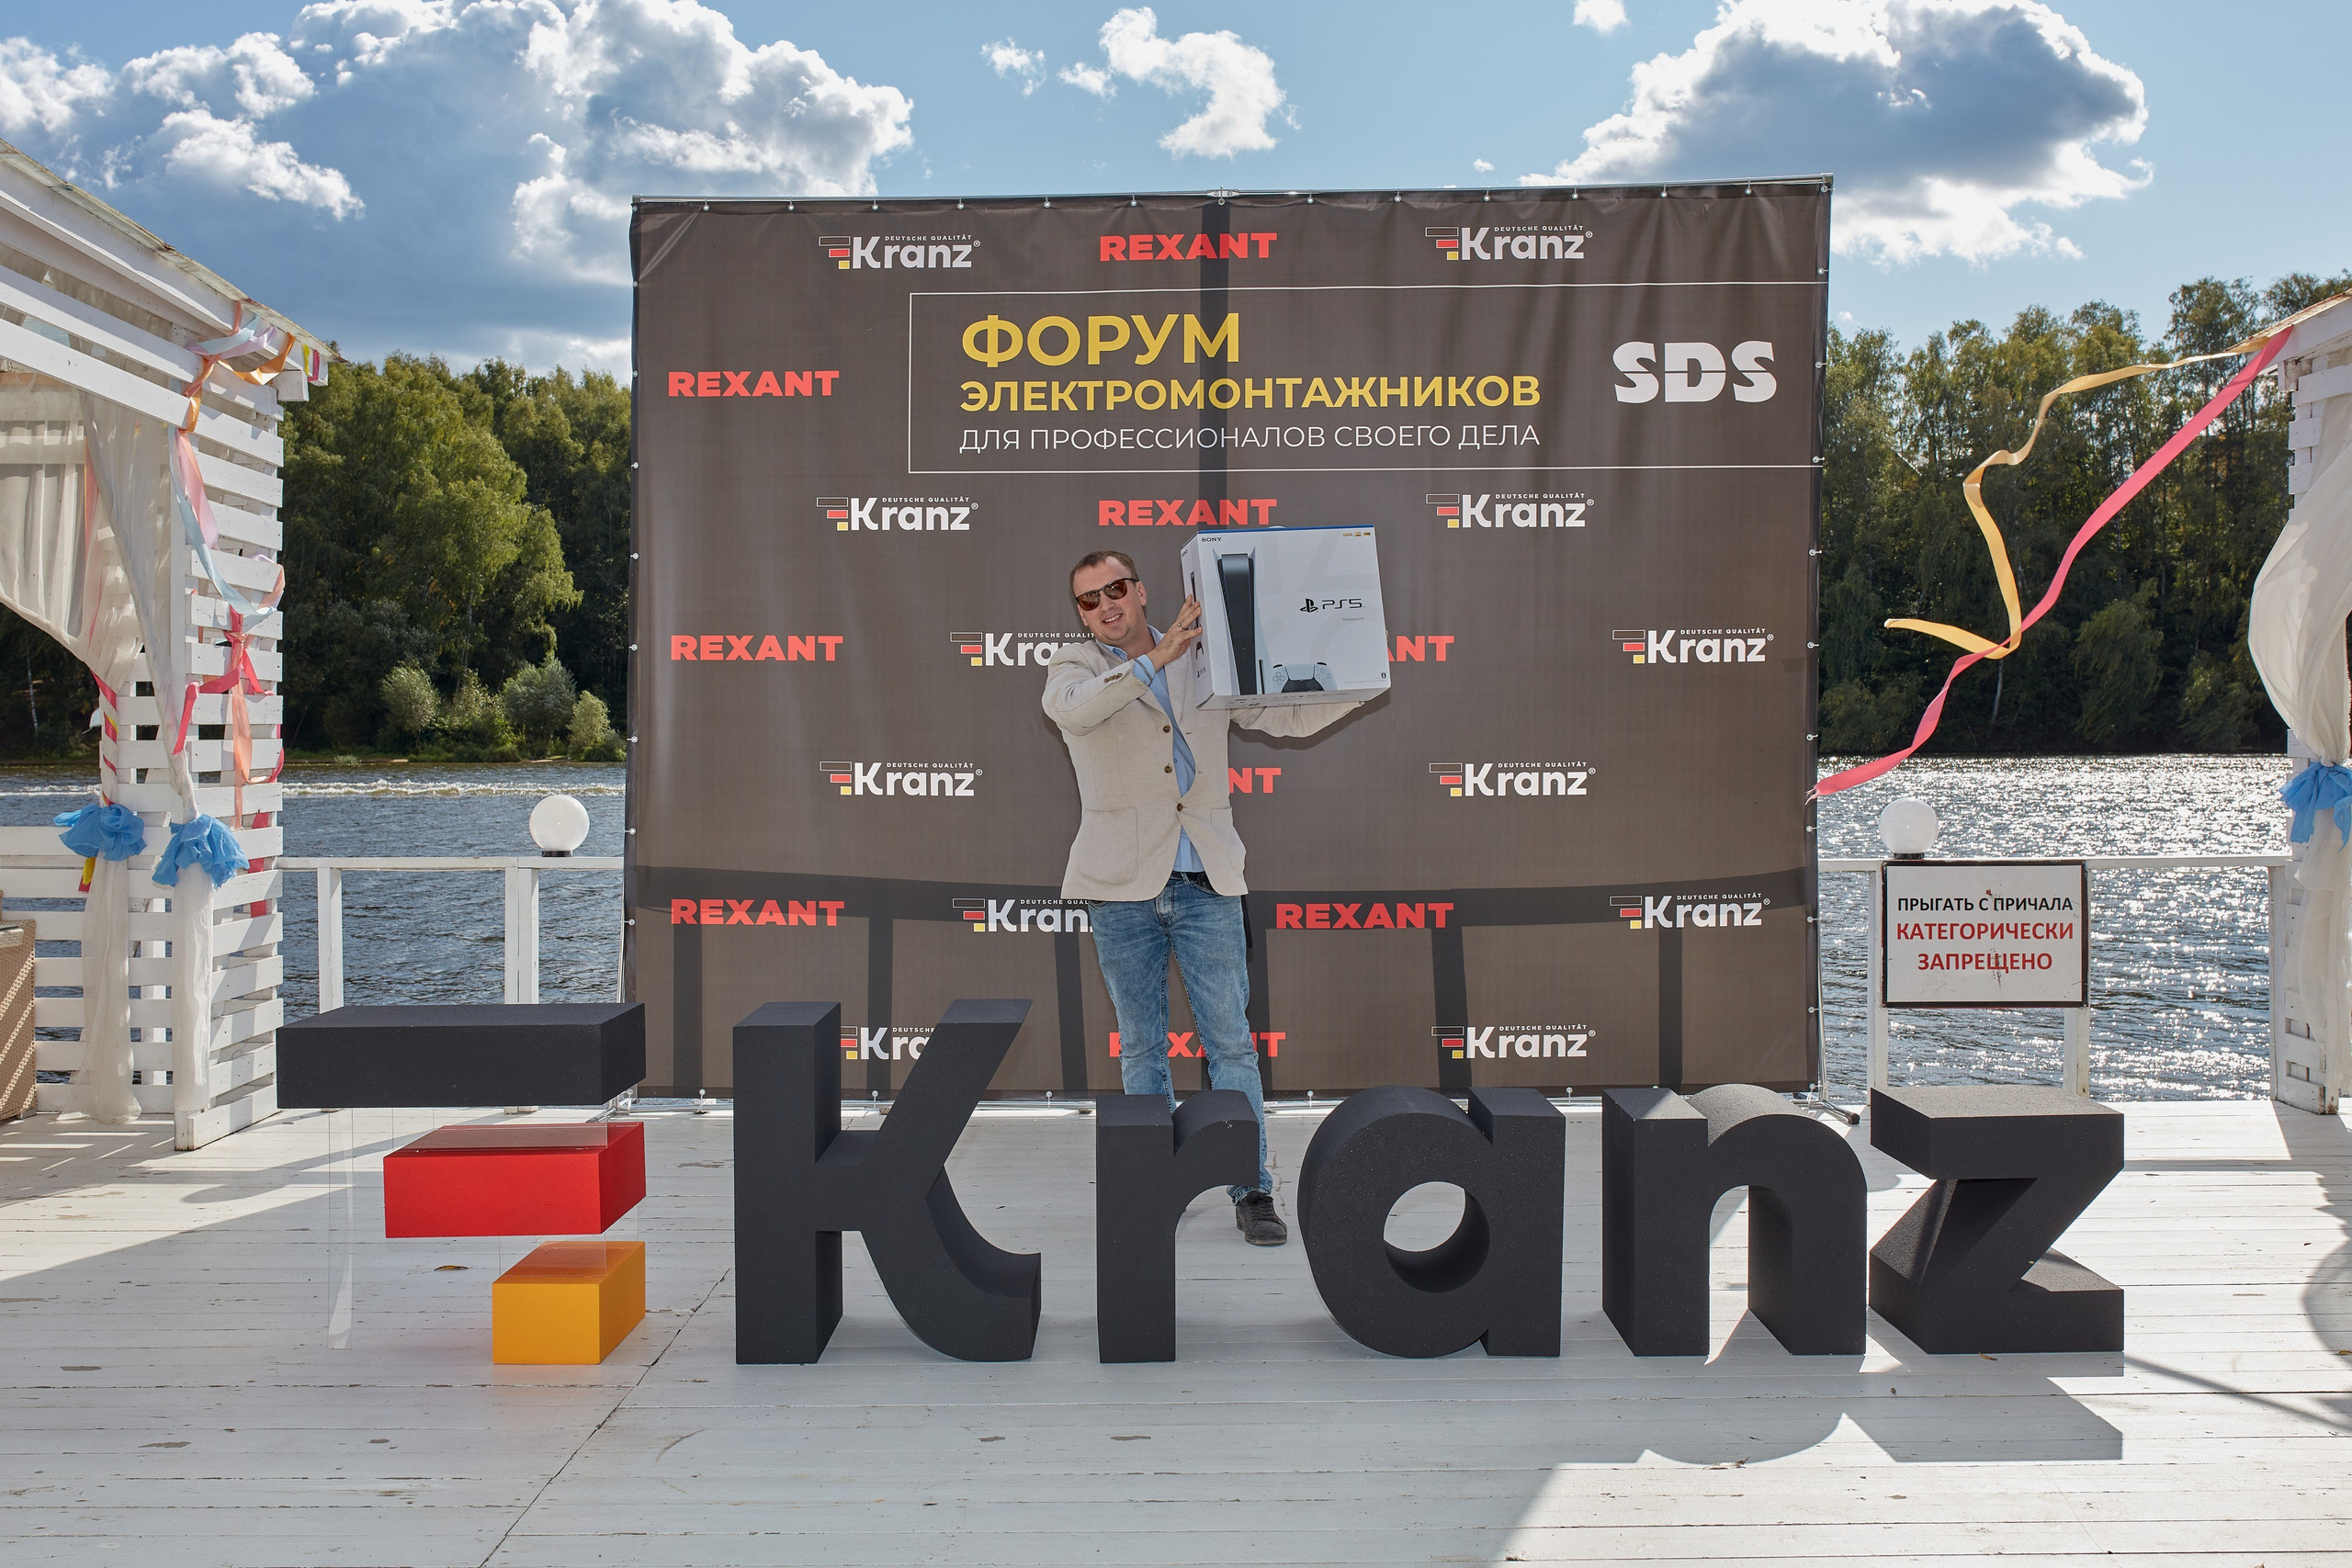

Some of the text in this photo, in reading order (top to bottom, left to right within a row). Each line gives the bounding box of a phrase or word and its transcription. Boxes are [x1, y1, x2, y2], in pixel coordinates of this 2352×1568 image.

[1099, 231, 1278, 262] REXANT
[962, 312, 1239, 368] ФОРУМ
[668, 369, 840, 398] REXANT
[1612, 340, 1777, 404] SDS
[961, 375, 1541, 412] ЭЛЕКТРОМОНТАЖНИКОВ
[958, 424, 1541, 455] ДЛЯ ПРОФЕССИОНАЛОВ СВОЕГО ДЕЛА
[1098, 498, 1277, 526] REXANT
[1321, 598, 1363, 610] PS5
[671, 635, 843, 662] REXANT
[671, 898, 845, 927] REXANT
[988, 899, 1093, 933] Kran
[1276, 902, 1454, 930] REXANT
[1897, 897, 2074, 911] ПРЫГАТЬ С ПРИЧАЛА
[1896, 922, 2074, 941] КАТЕГОРИЧЕСКИ
[1917, 953, 2052, 974] ЗАПРЕЩЕНО
[860, 1027, 930, 1060] Kra
[734, 999, 2124, 1365] Kranz
